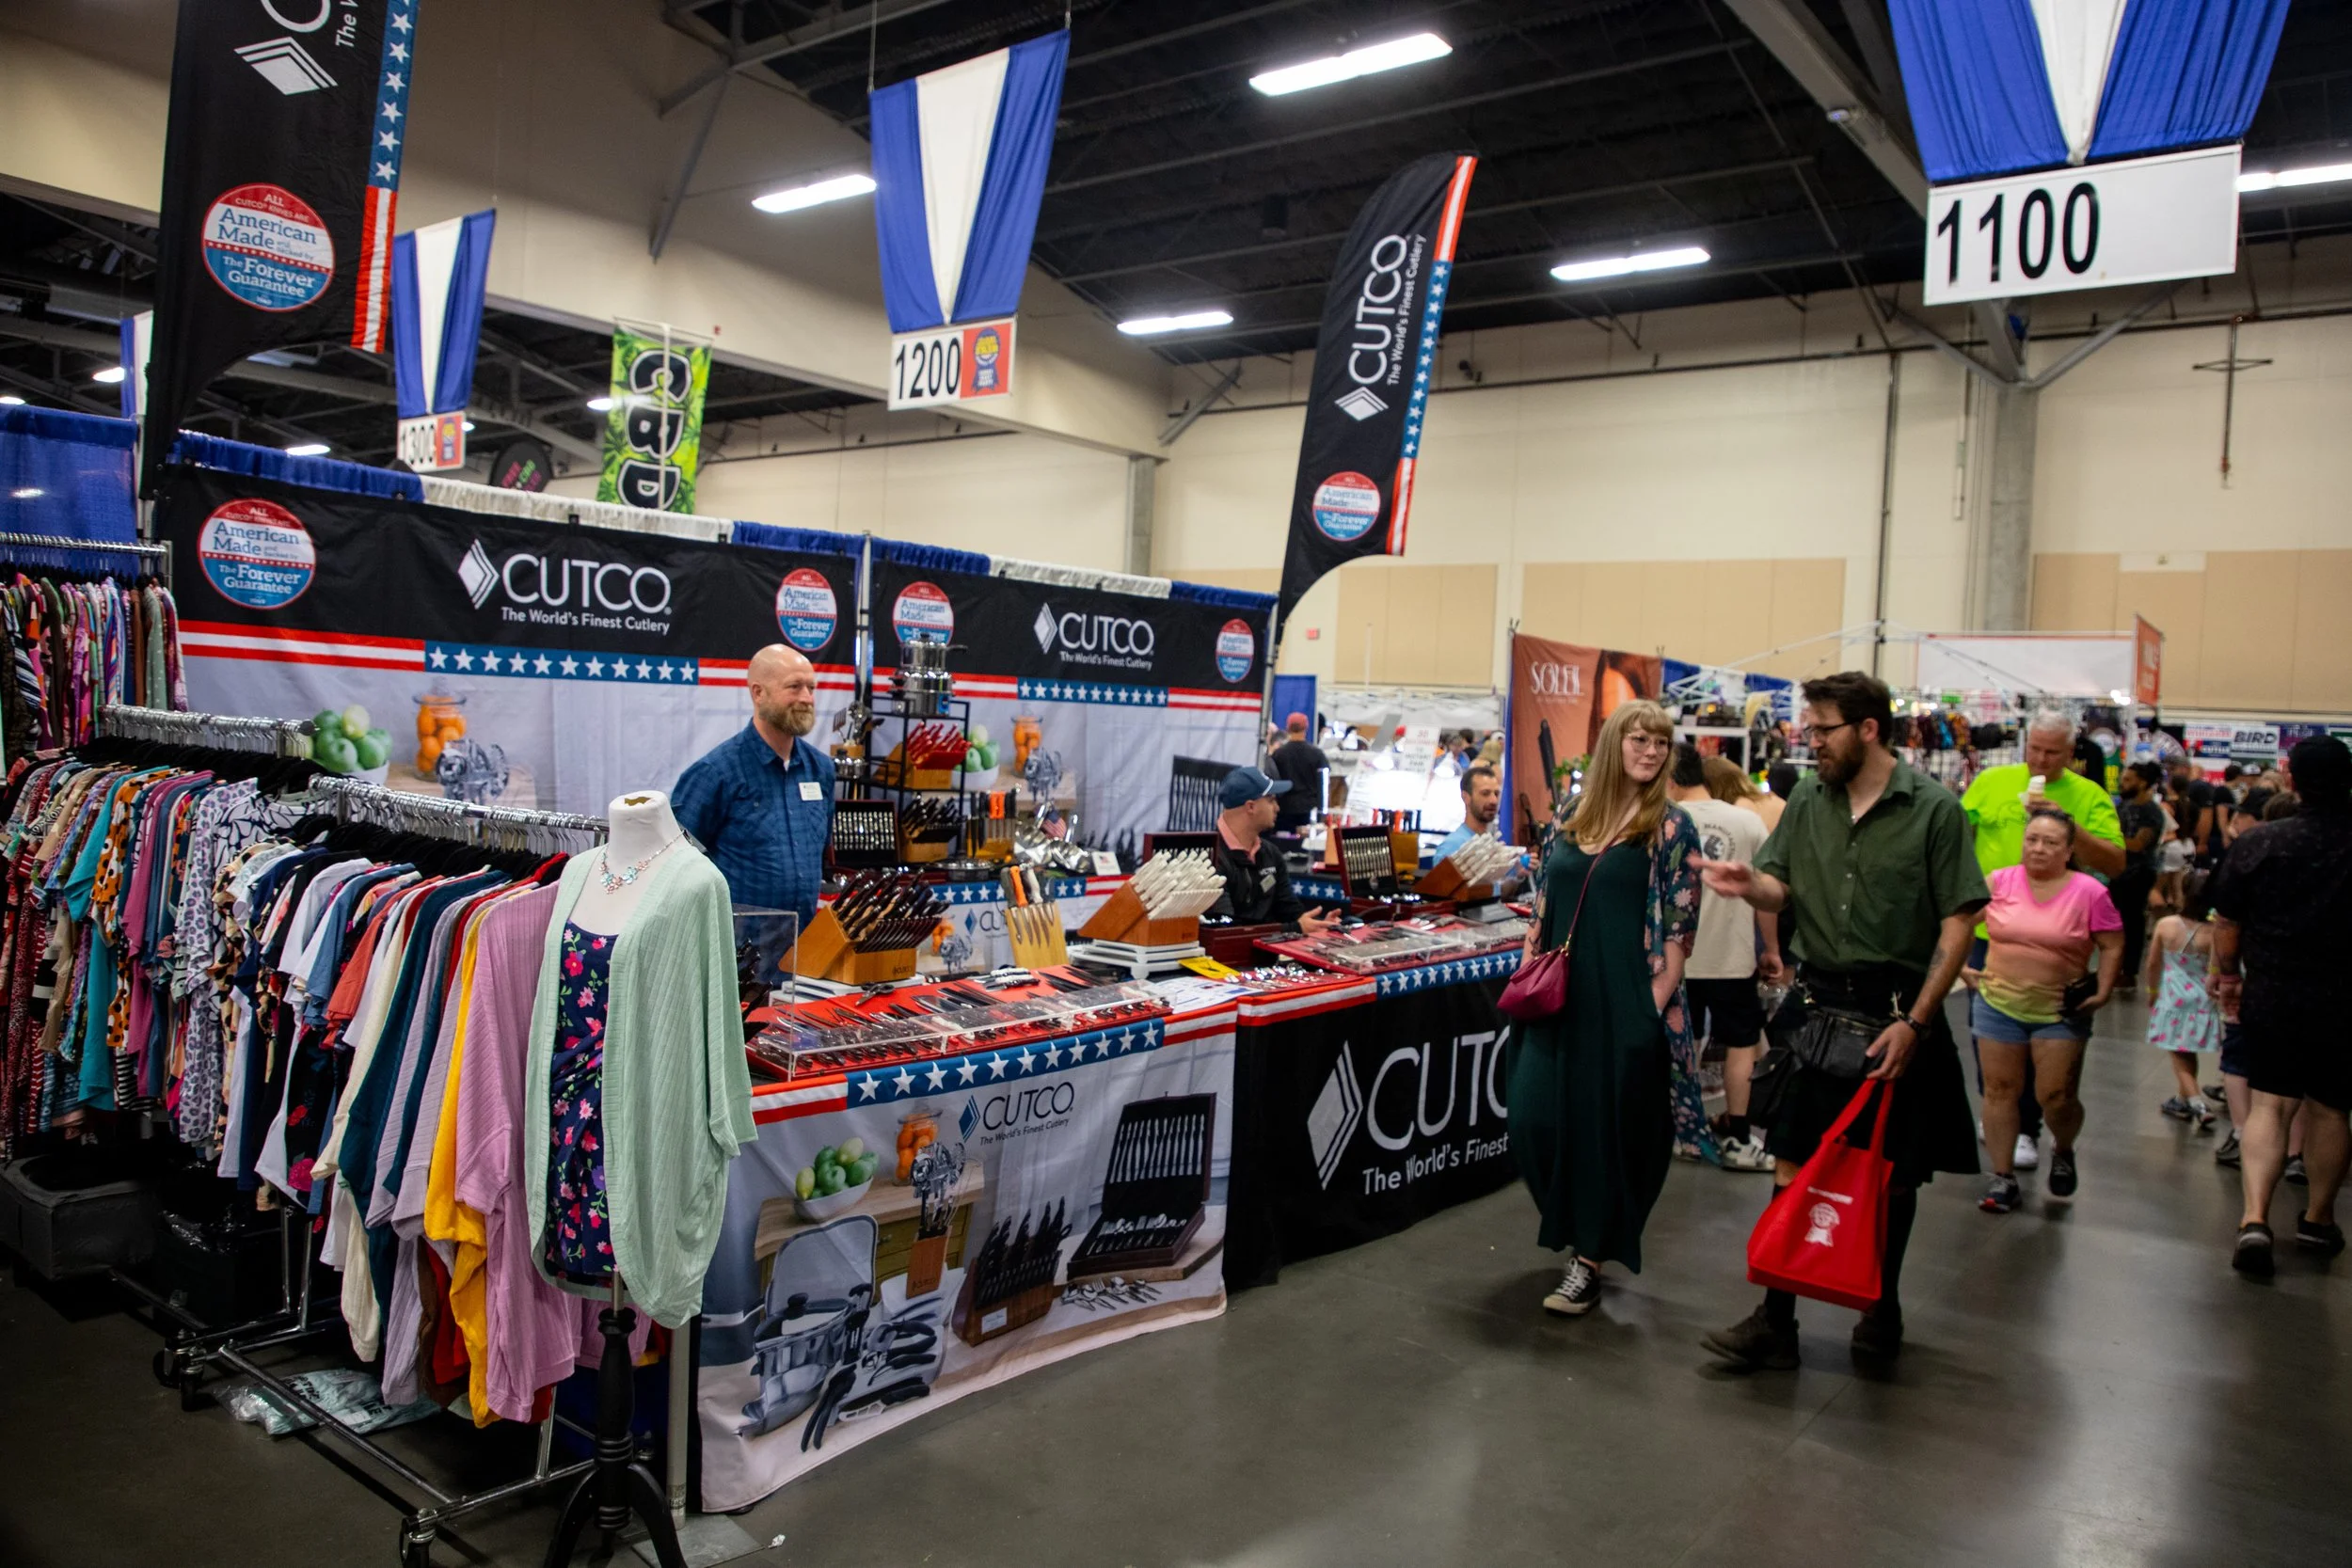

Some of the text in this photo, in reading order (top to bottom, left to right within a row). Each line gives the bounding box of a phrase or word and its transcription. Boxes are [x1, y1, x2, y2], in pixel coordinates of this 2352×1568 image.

[335, 13, 358, 47] The
[264, 194, 284, 206] ALL
[217, 224, 275, 249] Made
[219, 208, 317, 245] American
[1937, 181, 2100, 287] 1100
[222, 256, 316, 288] The Forever
[229, 270, 306, 297] Guarantee
[1348, 234, 1407, 385] CUTCO
[1387, 234, 1427, 386] The World's Finest Cutlery
[896, 337, 961, 400] 1200
[617, 349, 691, 511] CBD
[213, 536, 262, 556] Made
[214, 521, 299, 545] American
[218, 564, 301, 584] The Forever
[224, 577, 292, 594] Guarantee
[502, 553, 672, 613] CUTCO
[501, 607, 670, 636] The World's Finest Cutlery
[1058, 612, 1154, 656] CUTCO
[1059, 651, 1073, 662] The
[1125, 657, 1152, 672] Cutlery
[1367, 1024, 1510, 1150] CUTC
[983, 1082, 1074, 1131] CUTCO
[980, 1117, 1070, 1146] The World's Finest Cutlery
[1362, 1132, 1509, 1195] The World's Finest
